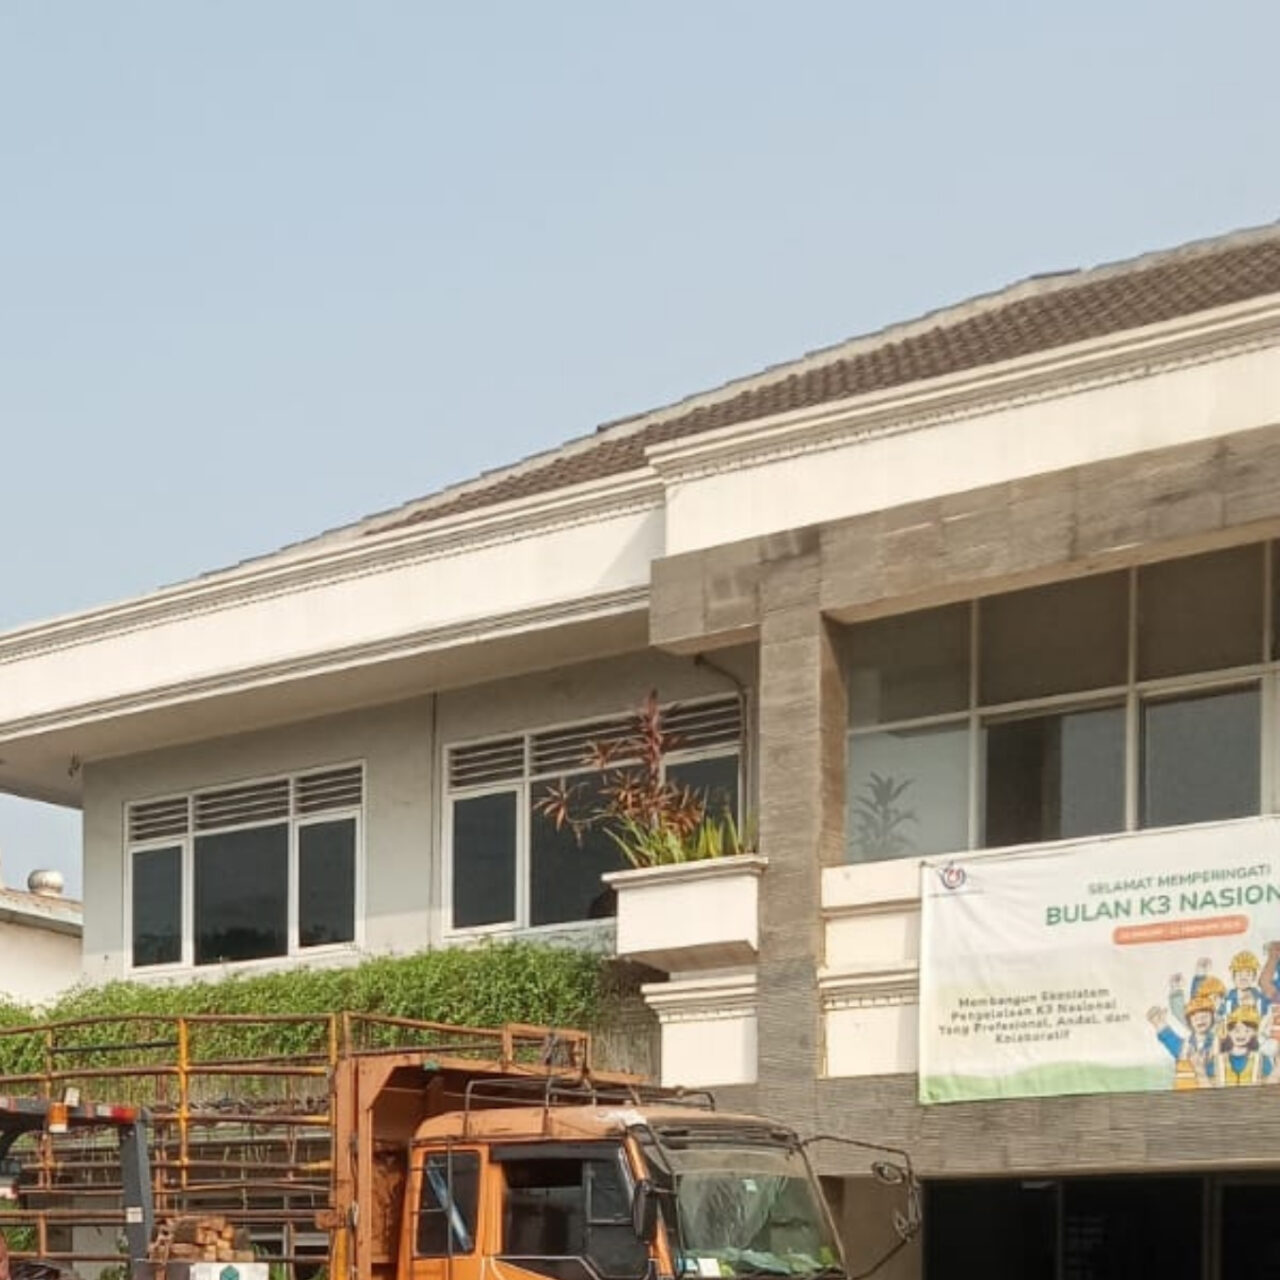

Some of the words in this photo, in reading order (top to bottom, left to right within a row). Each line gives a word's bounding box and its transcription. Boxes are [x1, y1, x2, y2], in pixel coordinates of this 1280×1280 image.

[1088, 877, 1153, 895] SELAMAT
[1158, 864, 1271, 887] MEMPERINGATI
[1046, 900, 1131, 926] BULAN
[1140, 895, 1170, 915] K3
